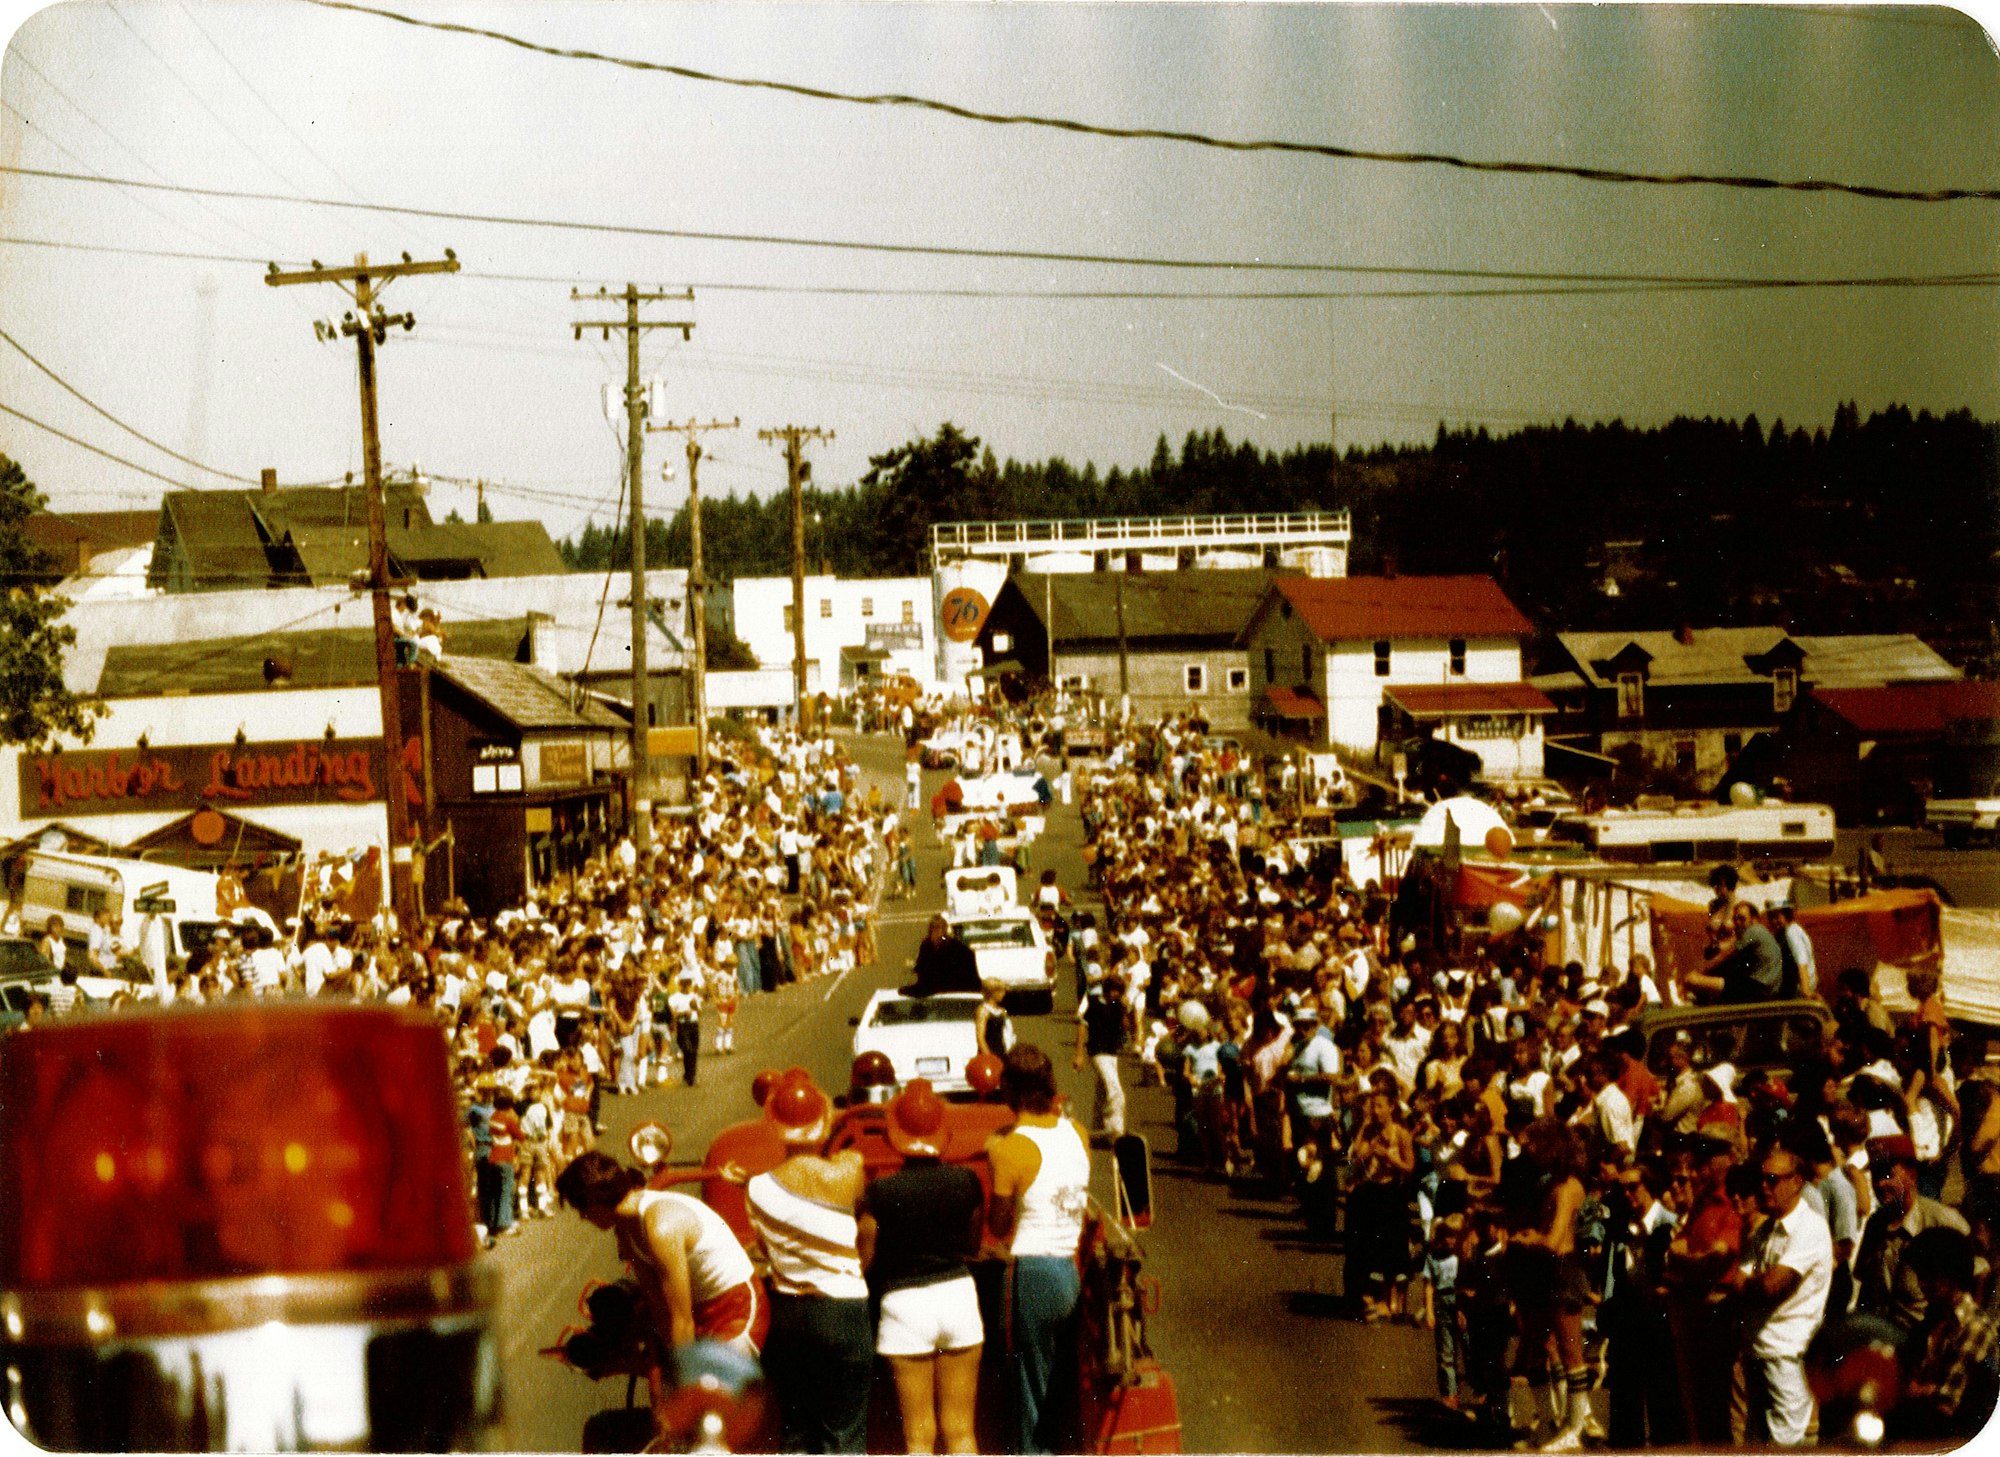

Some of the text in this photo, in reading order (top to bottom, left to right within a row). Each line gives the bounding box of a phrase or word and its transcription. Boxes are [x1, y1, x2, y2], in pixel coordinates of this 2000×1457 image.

[950, 597, 979, 625] 76
[36, 743, 375, 809] Harbor Landing
